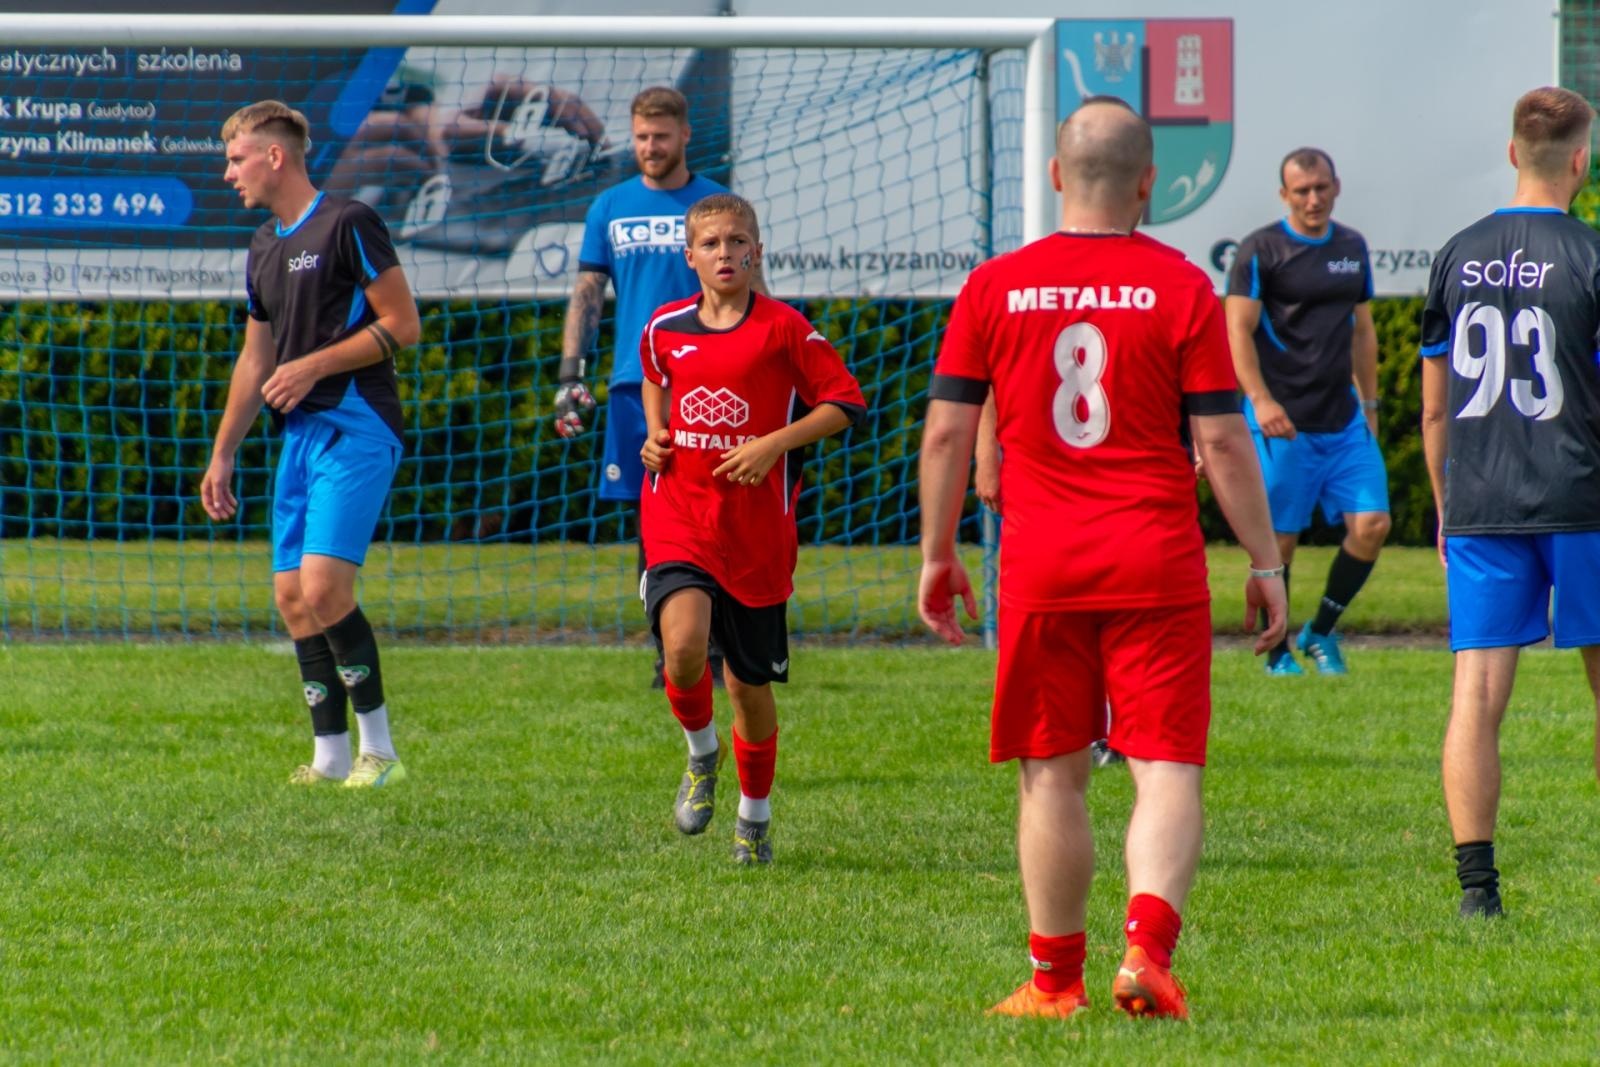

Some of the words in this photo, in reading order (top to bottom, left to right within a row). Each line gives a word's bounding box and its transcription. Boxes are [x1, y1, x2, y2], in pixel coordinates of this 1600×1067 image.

[0, 47, 116, 76] atycznych
[138, 47, 242, 71] szkolenia
[16, 96, 82, 124] Krupa
[87, 101, 156, 121] (audytor)
[57, 131, 157, 153] Klimanek
[0, 193, 42, 216] 512
[54, 193, 103, 216] 333
[113, 193, 165, 216] 494
[288, 250, 319, 272] safer
[767, 245, 978, 275] www.krzyzanow
[1327, 256, 1360, 273] safer
[1461, 248, 1554, 288] safer
[1008, 286, 1156, 313] METALIO
[1453, 302, 1564, 420] 93
[1053, 322, 1111, 448] 8
